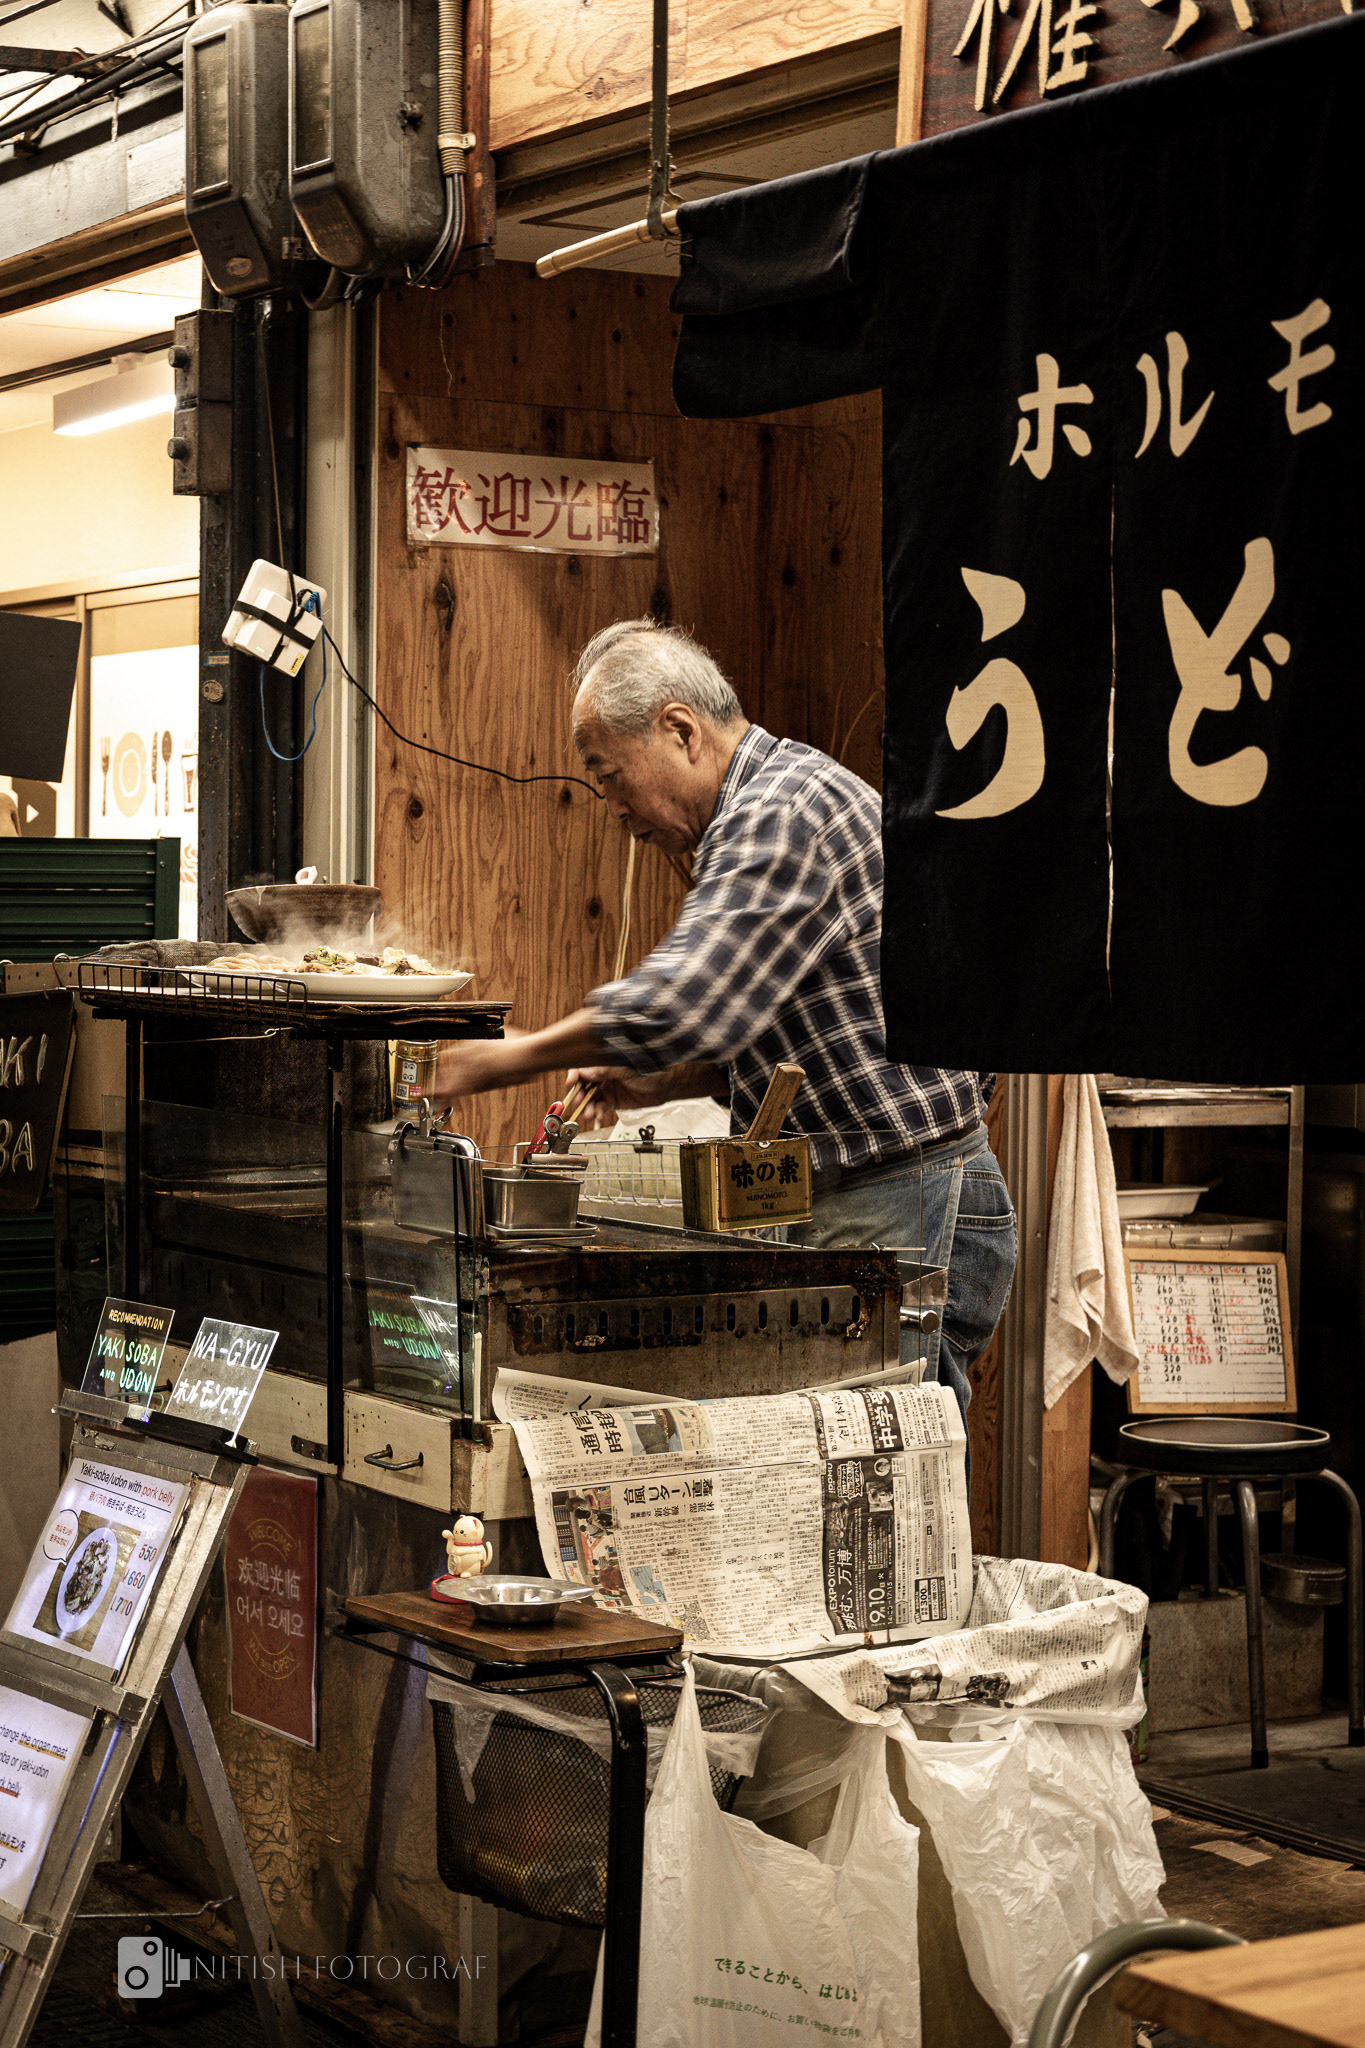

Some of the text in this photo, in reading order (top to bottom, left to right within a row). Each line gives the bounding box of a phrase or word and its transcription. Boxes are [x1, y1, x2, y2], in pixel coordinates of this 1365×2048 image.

[731, 1154, 799, 1189] 味の素
[761, 1202, 774, 1210] 1kg
[108, 1309, 165, 1331] RECOMMENDATION
[193, 1331, 269, 1371] WA-GYU
[119, 1368, 153, 1393] UDON
[80, 1462, 176, 1507] Yaki-soba/udon with pork belly
[139, 1544, 158, 1563] 550
[249, 1525, 292, 1557] WELCOME
[127, 1571, 146, 1589] 660
[237, 1557, 301, 1601] 欢迎光临
[115, 1596, 133, 1616] 770
[236, 1596, 305, 1638] 어서 오세요
[272, 1651, 296, 1673] OPEN
[19, 1731, 31, 1745] the
[31, 1737, 51, 1752] organ
[52, 1743, 69, 1758] meat
[10, 1757, 19, 1767] or
[17, 1759, 50, 1779] yaki-udon
